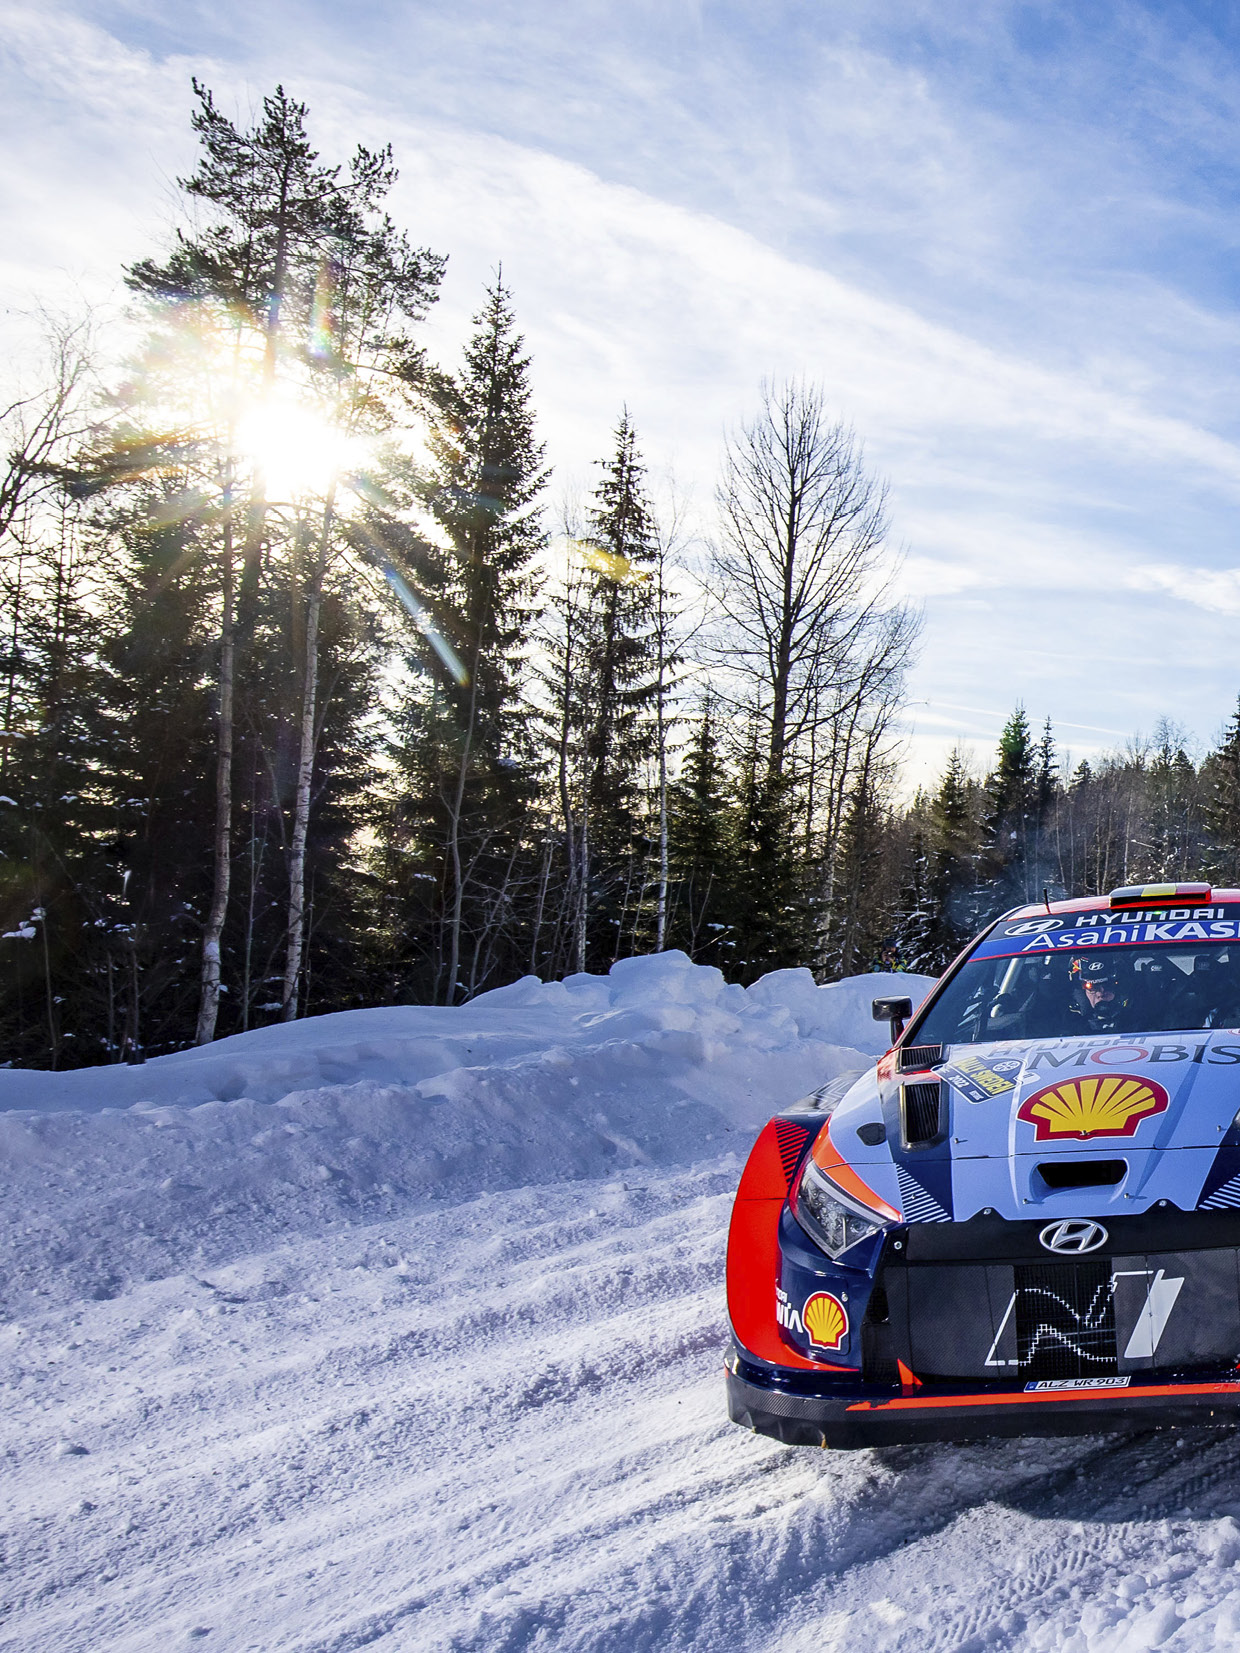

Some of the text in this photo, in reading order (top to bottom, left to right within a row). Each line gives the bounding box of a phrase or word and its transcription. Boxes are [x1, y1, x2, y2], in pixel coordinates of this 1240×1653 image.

[1075, 908, 1225, 927] HYUNDAI
[948, 1075, 970, 1088] 2022
[970, 1069, 1015, 1095] SWEDEN
[1038, 1380, 1069, 1388] ALZ
[1096, 1377, 1126, 1385] 903
